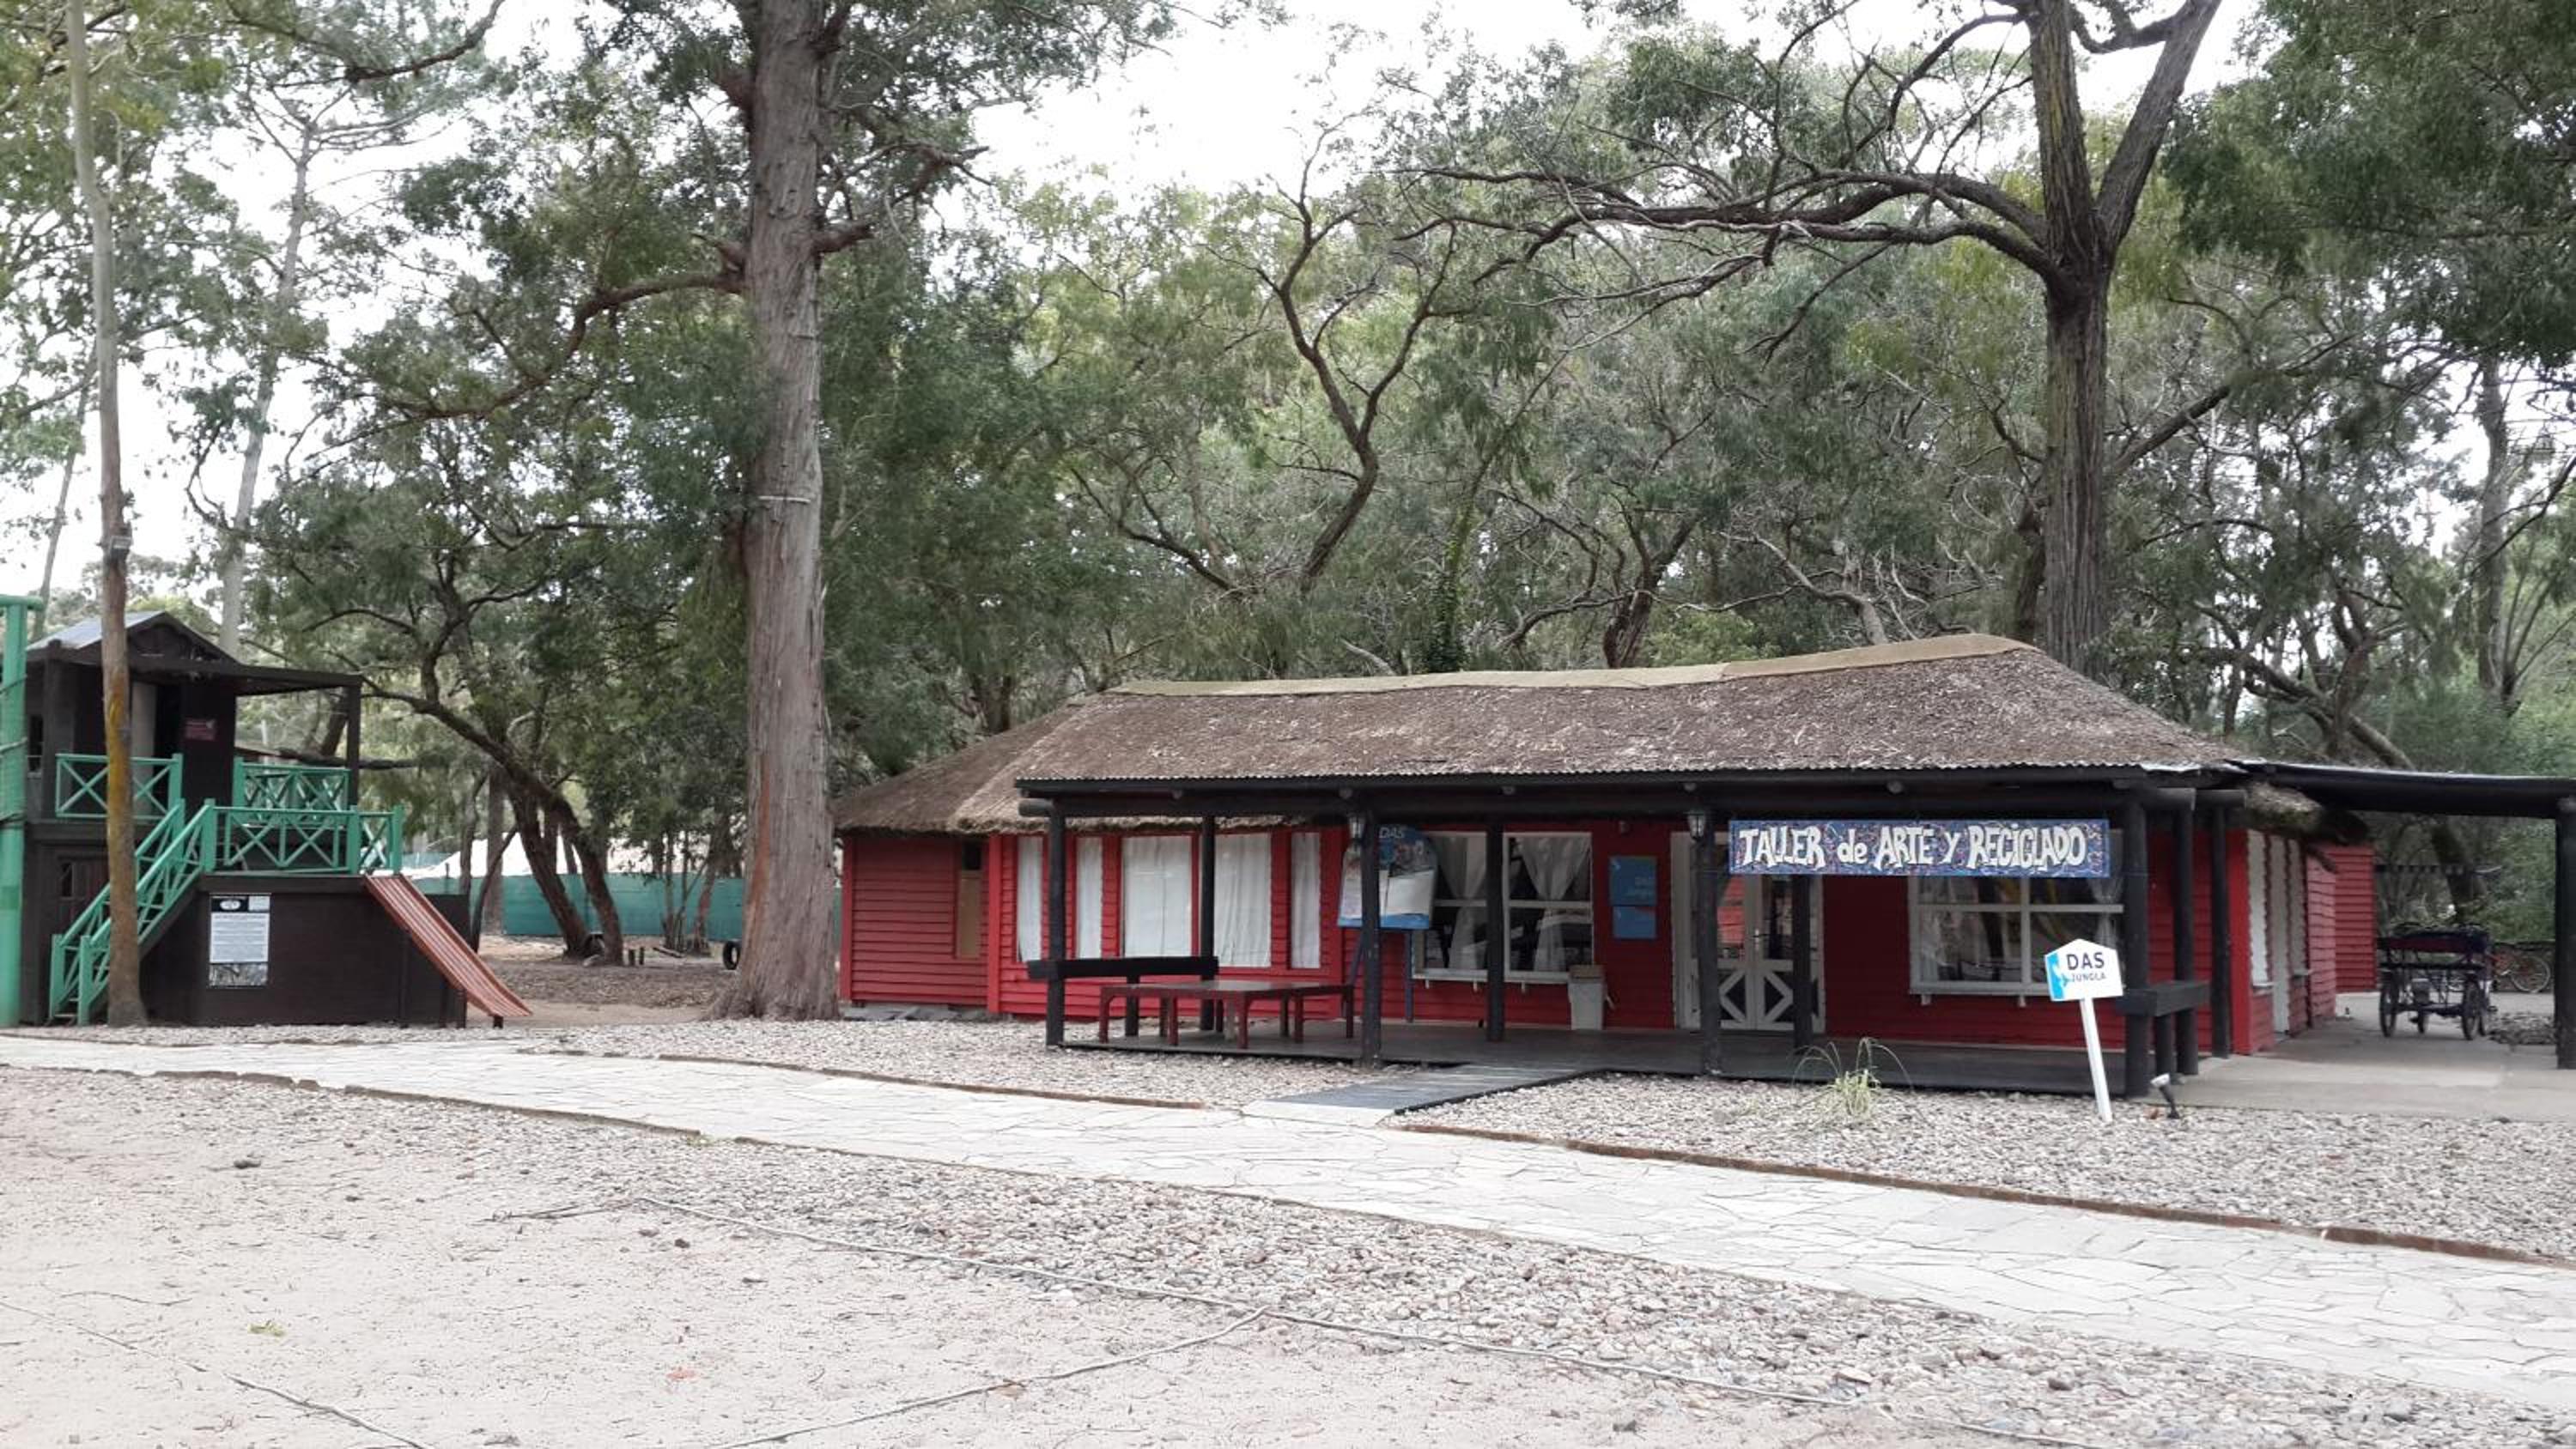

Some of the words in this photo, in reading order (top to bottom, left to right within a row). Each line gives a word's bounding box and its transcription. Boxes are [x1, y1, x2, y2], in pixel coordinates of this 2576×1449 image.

[1738, 825, 1826, 870] TALLER
[1837, 828, 1868, 864] de
[1873, 825, 1934, 870] ARTE
[2066, 952, 2105, 970] DAS
[2072, 971, 2107, 983] JUNGLA
